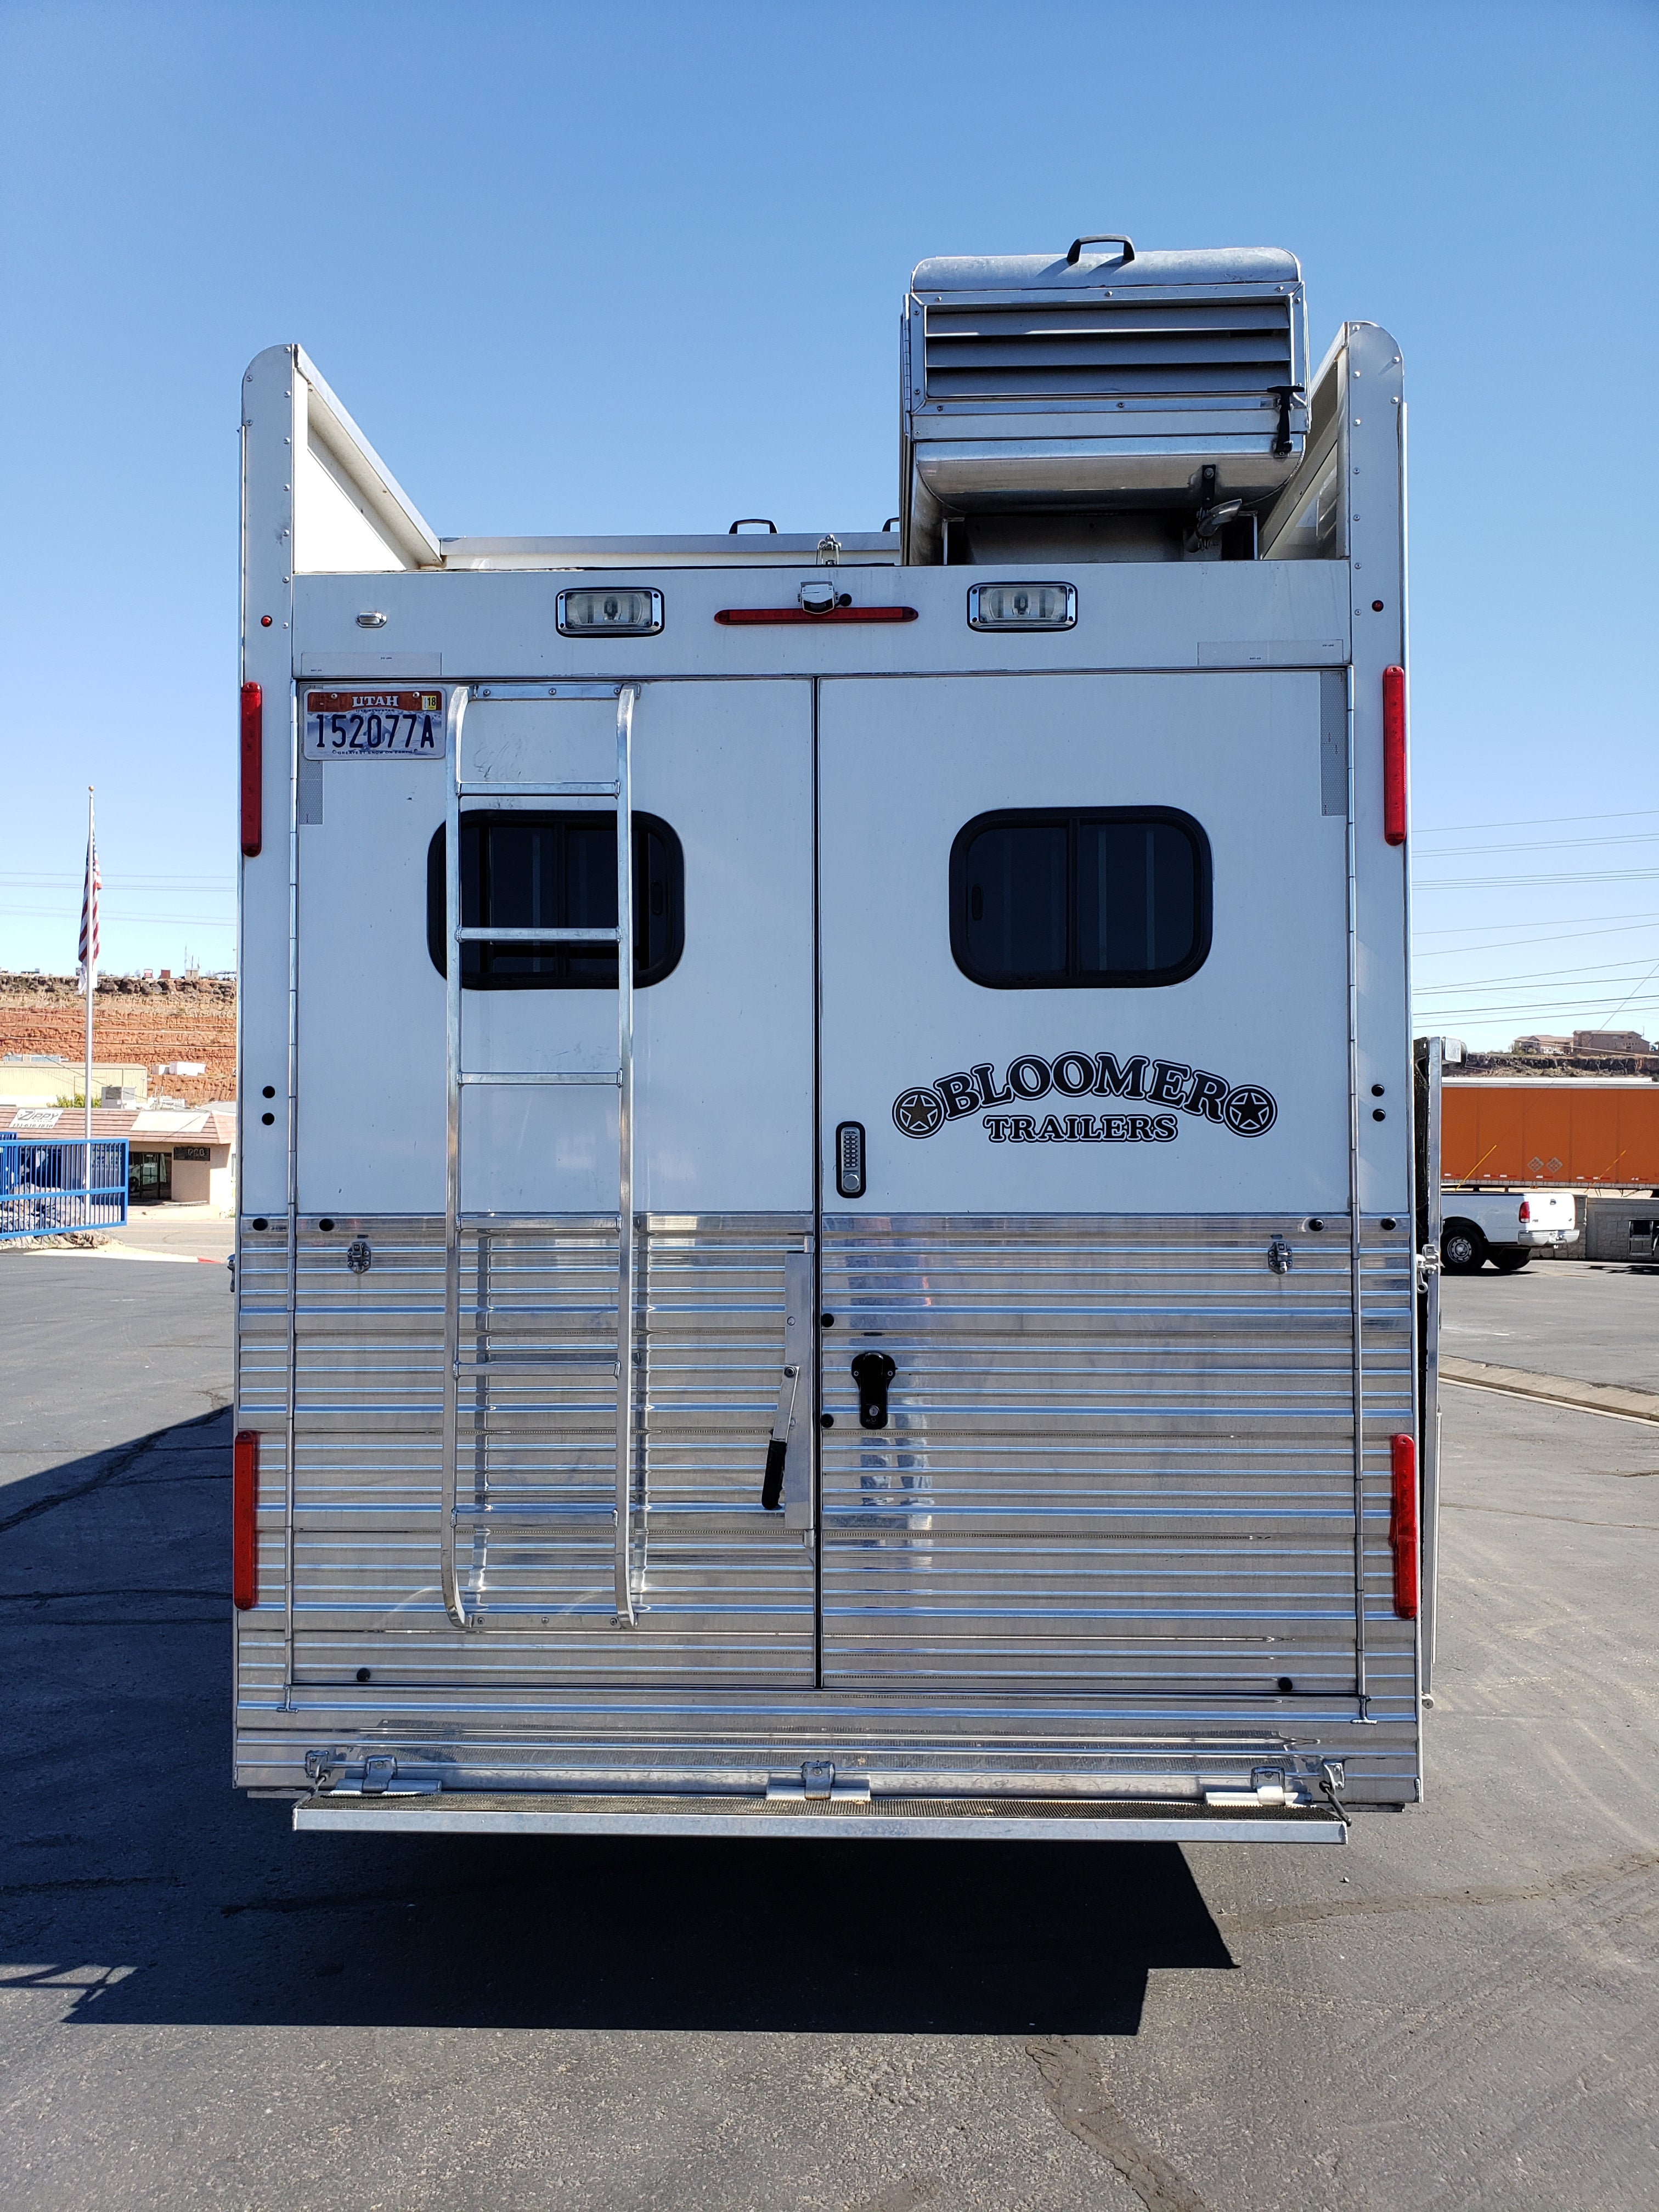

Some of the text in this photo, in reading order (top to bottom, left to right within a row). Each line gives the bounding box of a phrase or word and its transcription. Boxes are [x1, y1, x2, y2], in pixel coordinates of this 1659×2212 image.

[352, 696, 399, 707] UTAH
[428, 697, 436, 706] 18
[316, 714, 435, 748] 152077A
[934, 1051, 1232, 1124] BLOOMER
[984, 1114, 1178, 1143] TRAILERS
